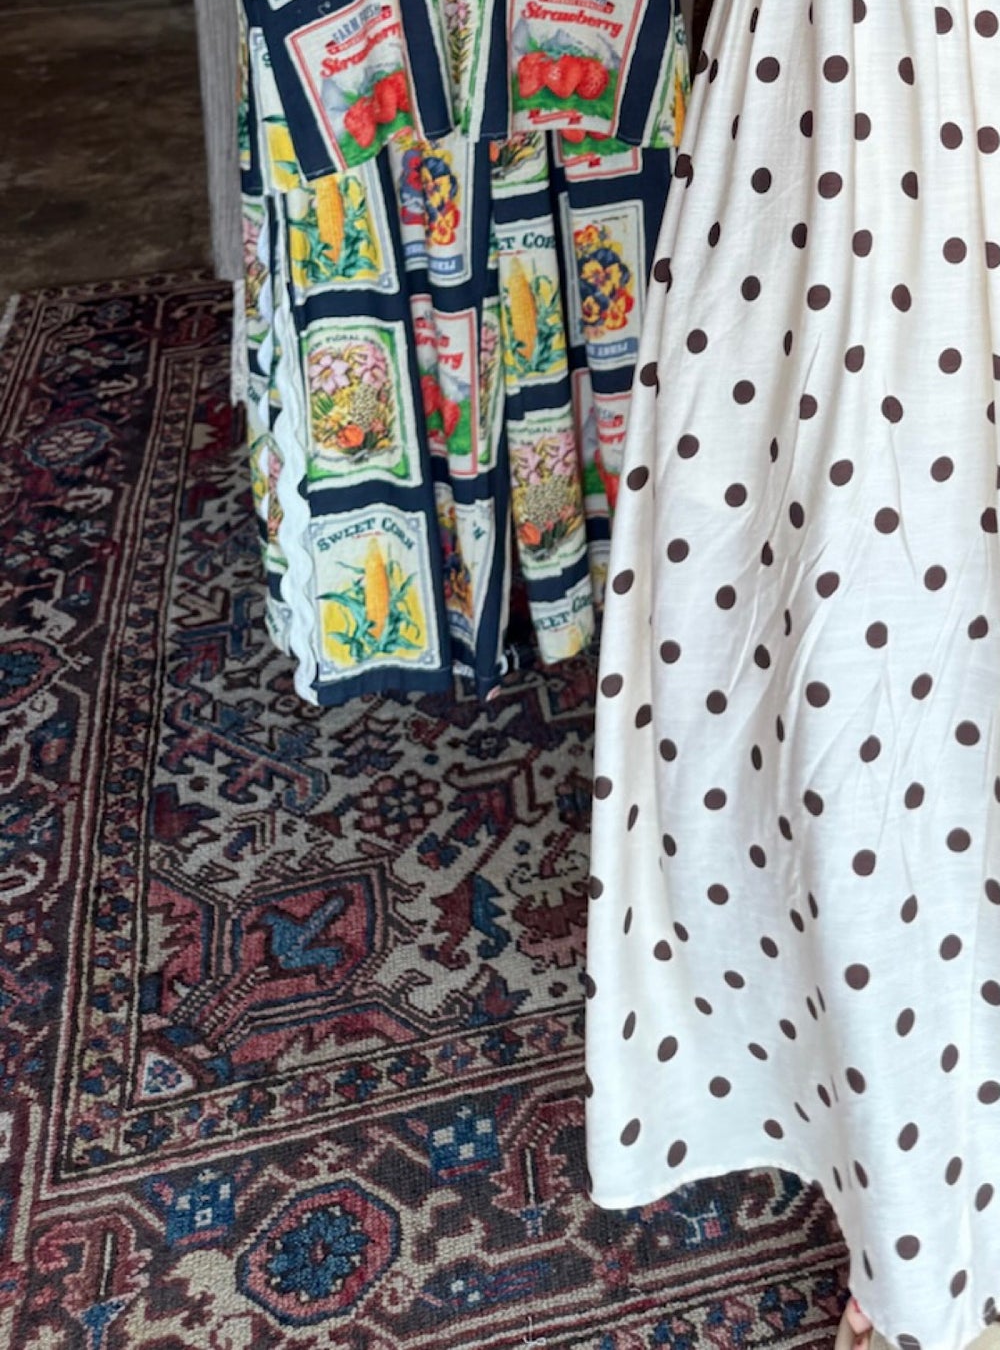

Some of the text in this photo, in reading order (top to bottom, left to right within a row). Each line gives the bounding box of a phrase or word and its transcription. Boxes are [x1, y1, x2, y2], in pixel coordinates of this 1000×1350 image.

[332, 16, 361, 42] FARM
[521, 1, 624, 39] Strawberry
[316, 517, 416, 552] SWEET CORN
